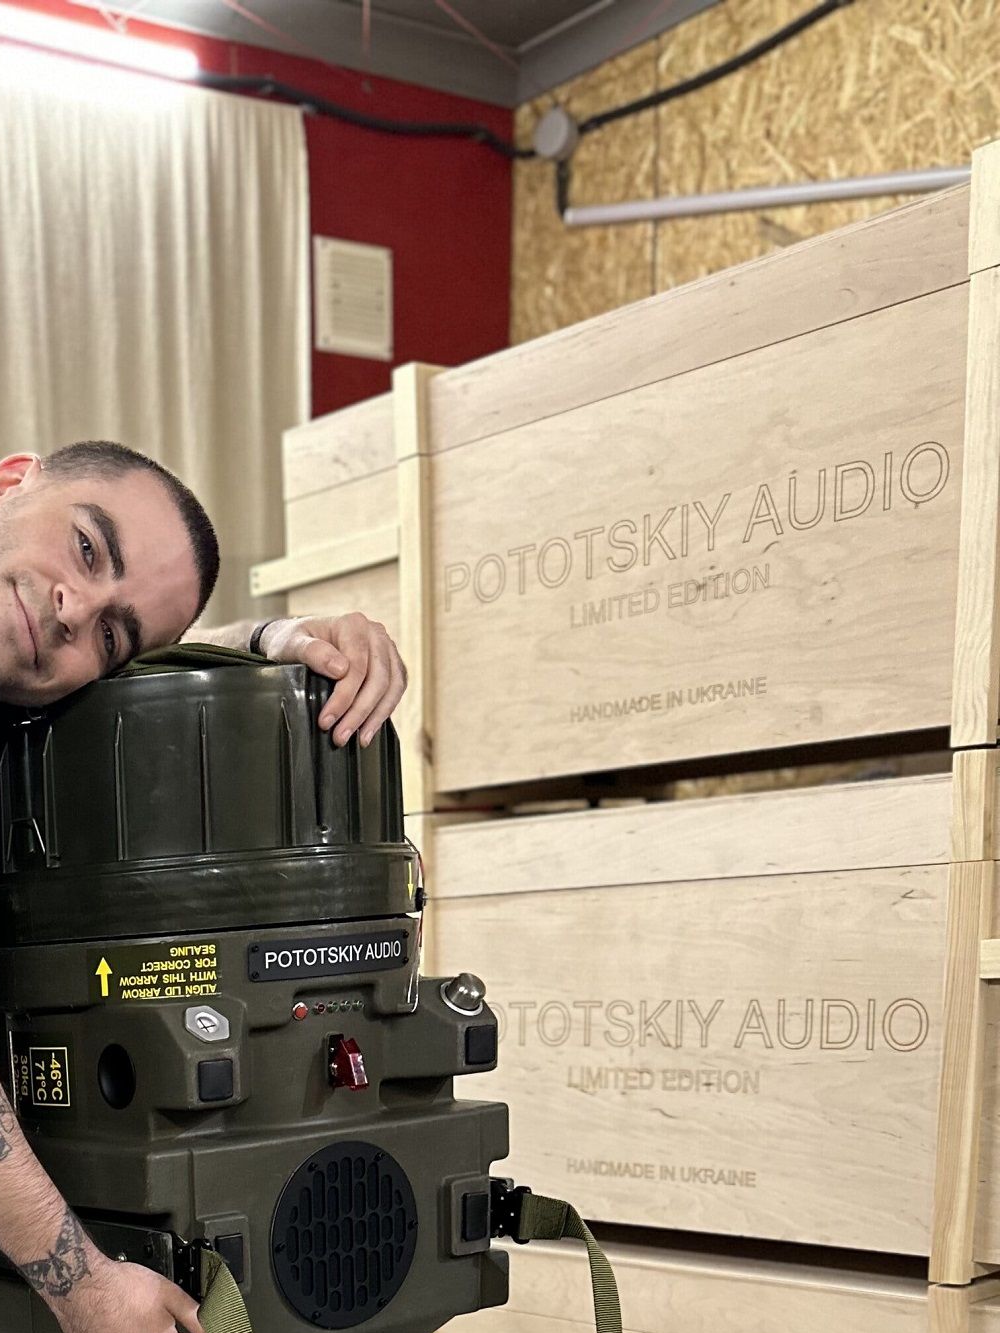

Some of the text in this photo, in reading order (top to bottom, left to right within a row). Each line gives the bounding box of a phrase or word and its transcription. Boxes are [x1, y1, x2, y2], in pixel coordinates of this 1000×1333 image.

[443, 440, 951, 613] POTOTSKIY AUDIO
[569, 563, 770, 630] LIMITED EDITION
[569, 676, 768, 724] HANDMADE IN UKRAINE
[140, 957, 217, 973] FOR CORRECT
[169, 944, 216, 957] SEALING
[264, 940, 401, 969] POTOTSKIY AUDIO
[119, 970, 218, 987] WITH THIS ARROW
[121, 983, 218, 999] ALIGN LID ARROW
[488, 996, 930, 1052] TOTSKIY AUDIO
[34, 1060, 47, 1101] 71°C
[49, 1051, 64, 1101] -46°C
[566, 1065, 760, 1094] LIMITED EDITION
[566, 1157, 757, 1188] HANDMADE IN UKRAINE
